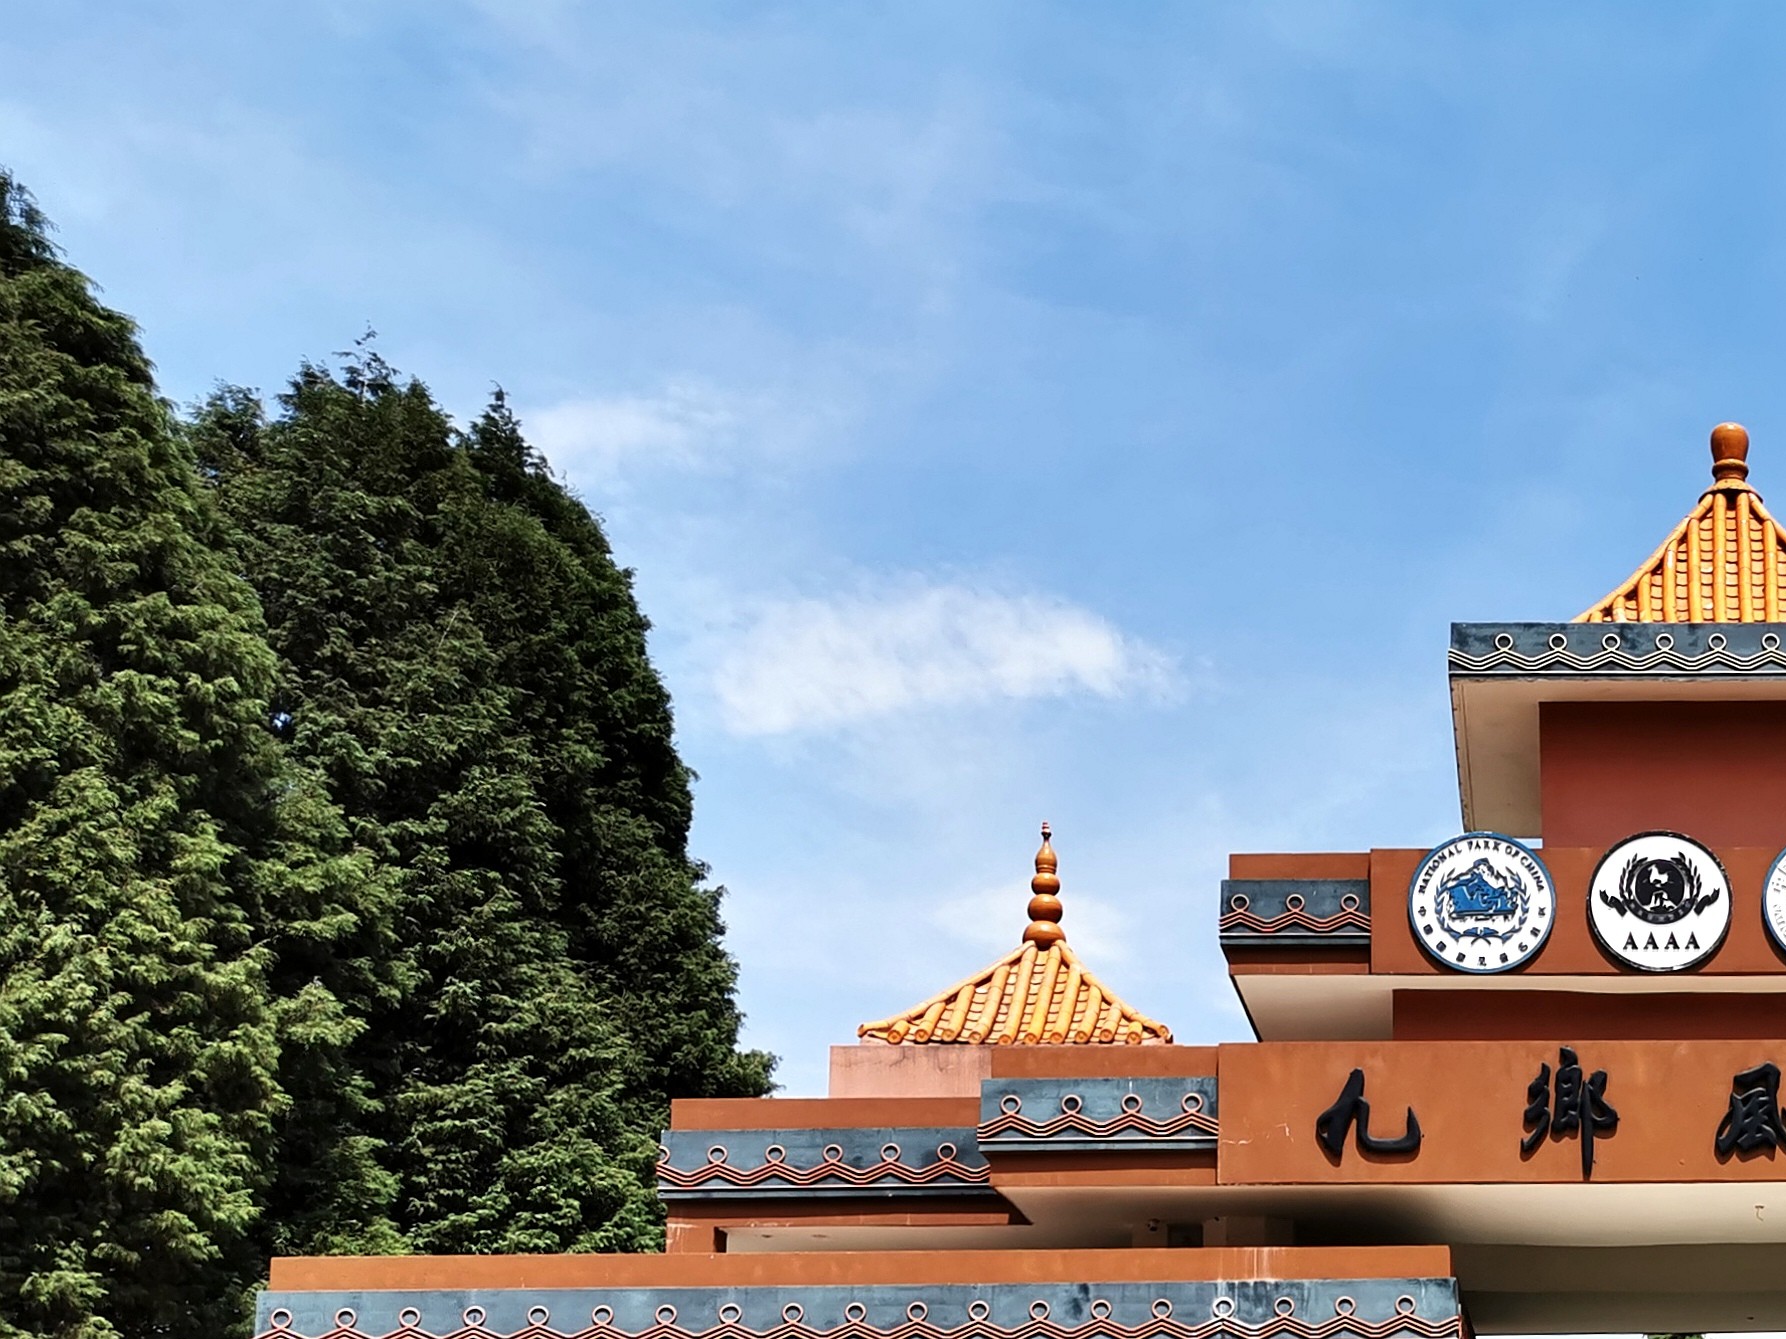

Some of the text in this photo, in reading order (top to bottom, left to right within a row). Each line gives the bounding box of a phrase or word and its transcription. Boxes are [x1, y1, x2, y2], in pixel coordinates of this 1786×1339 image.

[1418, 840, 1545, 894] NATIONAL PARK OF CHINA
